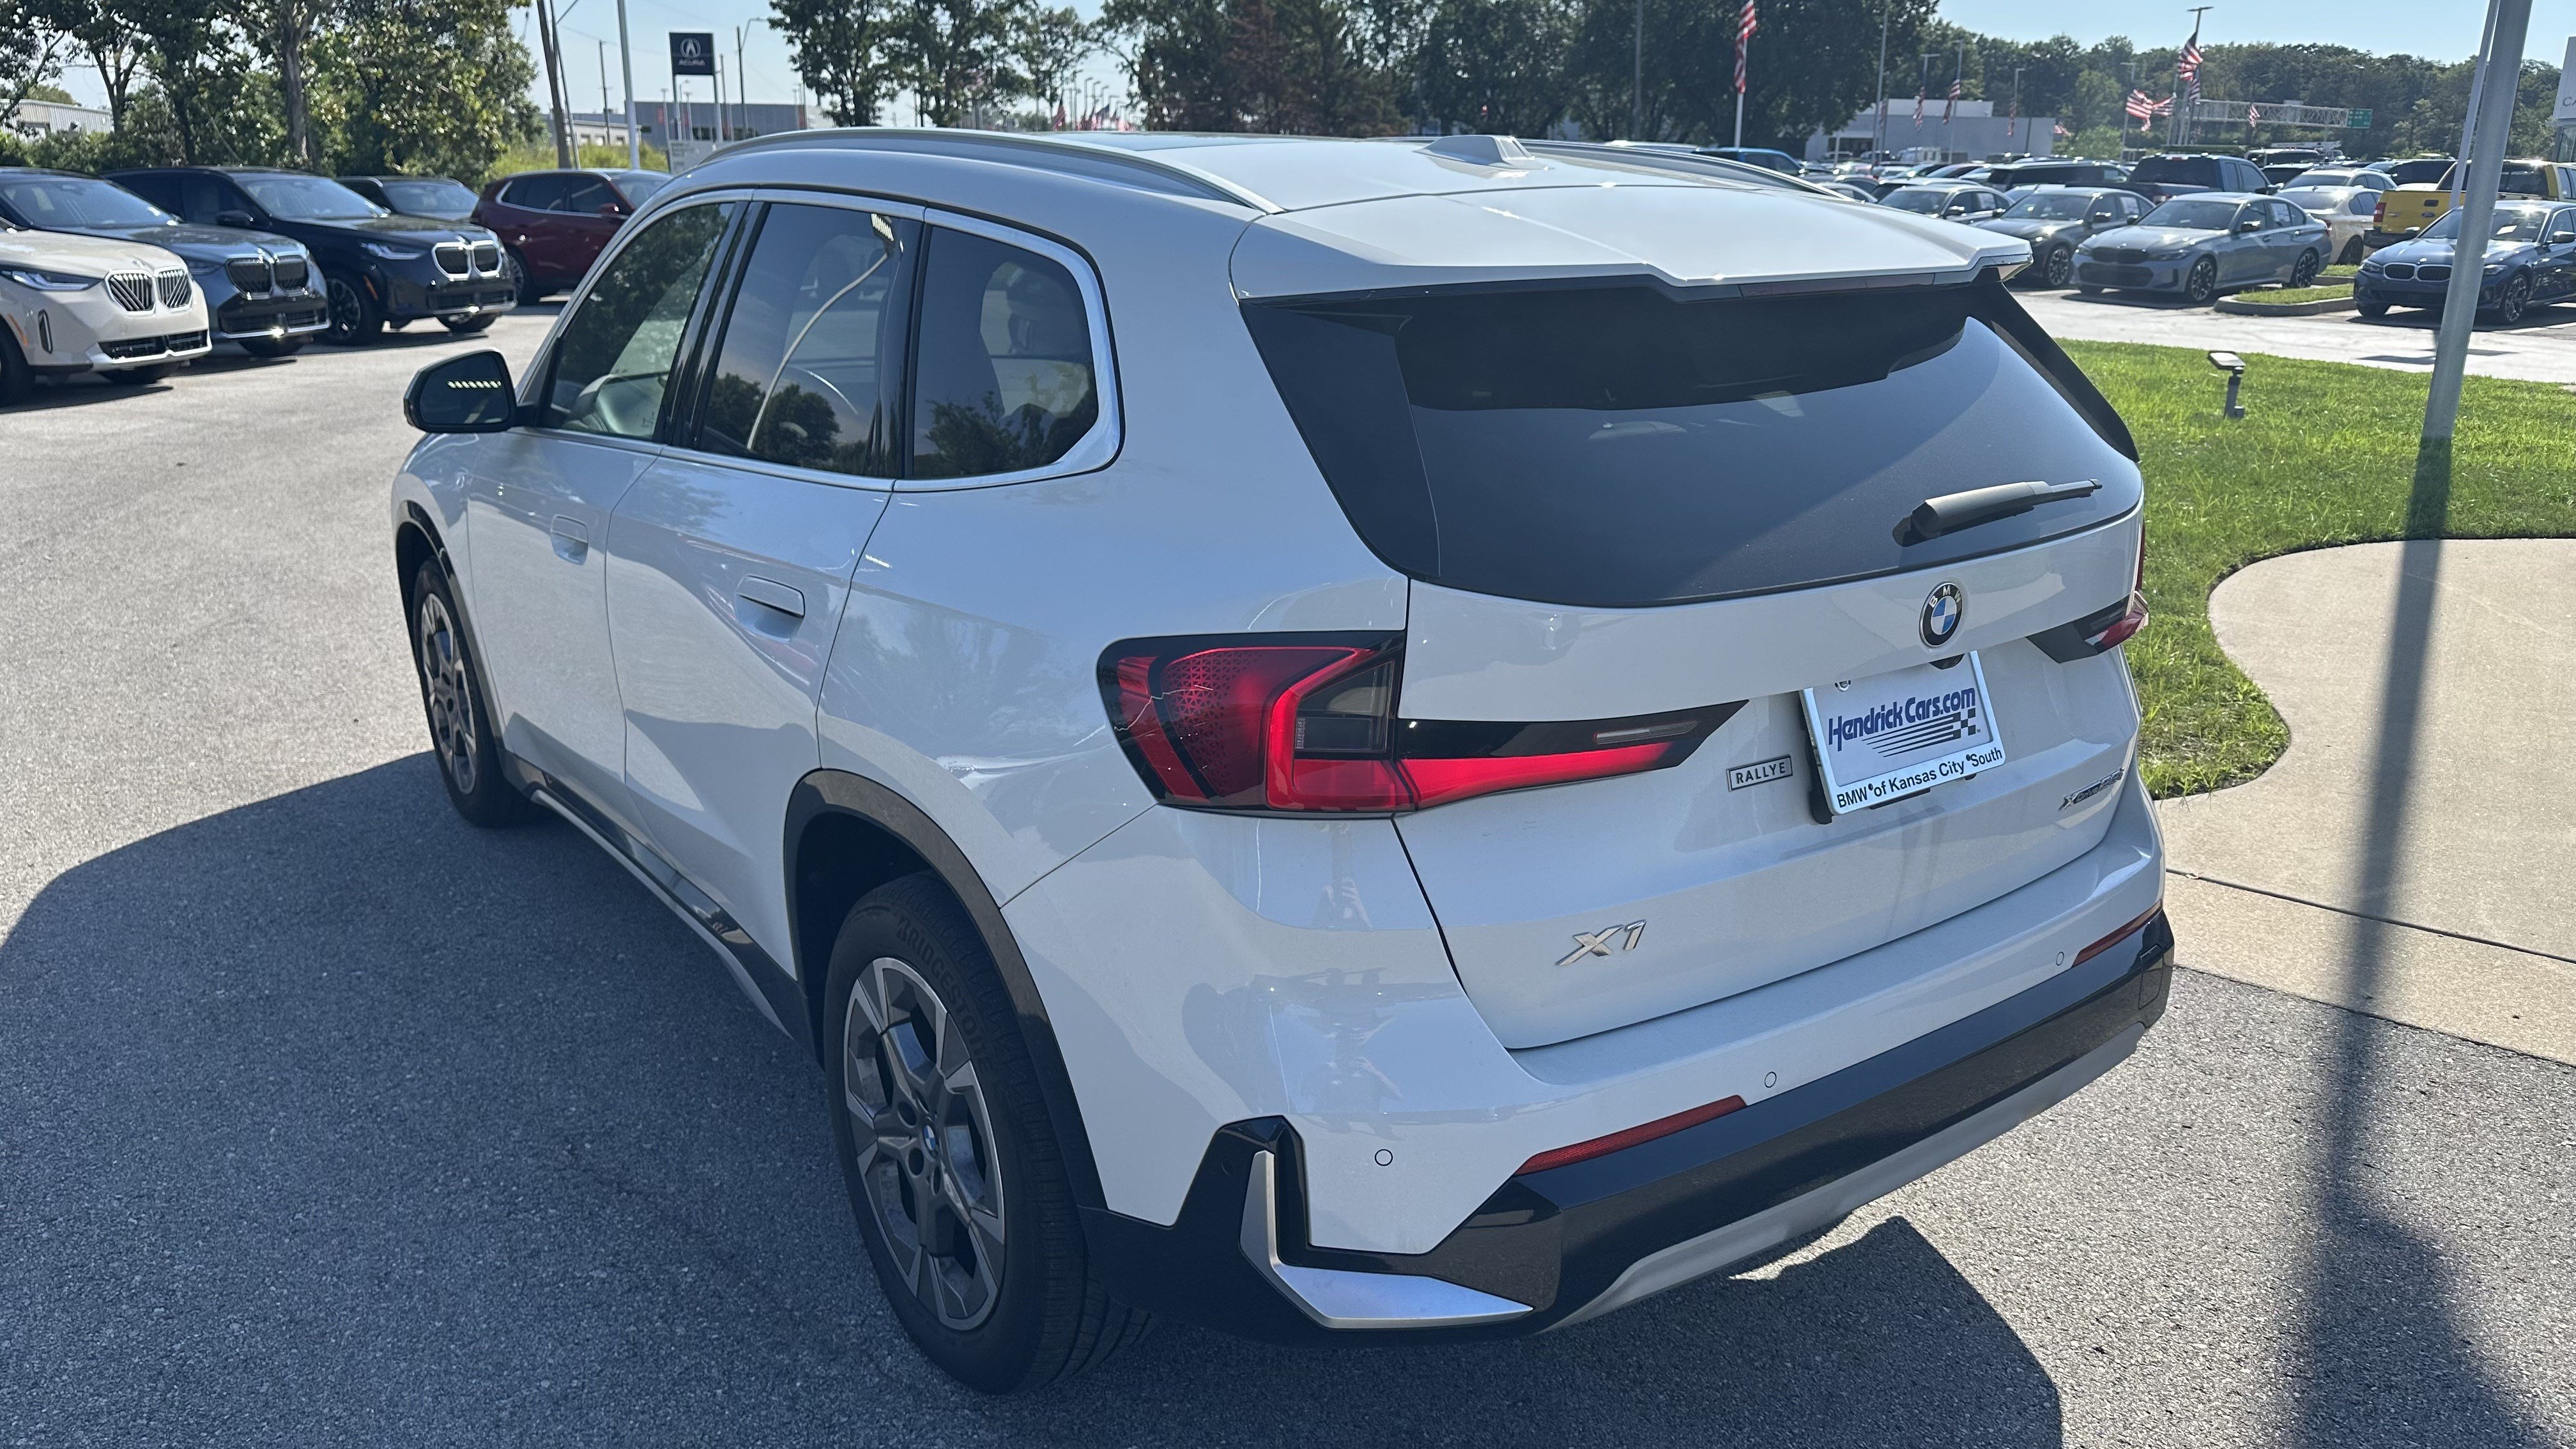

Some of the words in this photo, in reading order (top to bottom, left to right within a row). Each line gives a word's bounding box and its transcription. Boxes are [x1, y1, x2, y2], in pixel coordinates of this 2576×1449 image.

[1928, 585, 1962, 608] BMW
[1735, 762, 1786, 785] RALLYE
[1836, 786, 1868, 808] BMW
[1873, 778, 1887, 797] of
[1888, 769, 1937, 792] Kansas
[1938, 758, 1965, 777] City
[1970, 747, 2003, 767] South
[1554, 919, 1647, 967] X1
